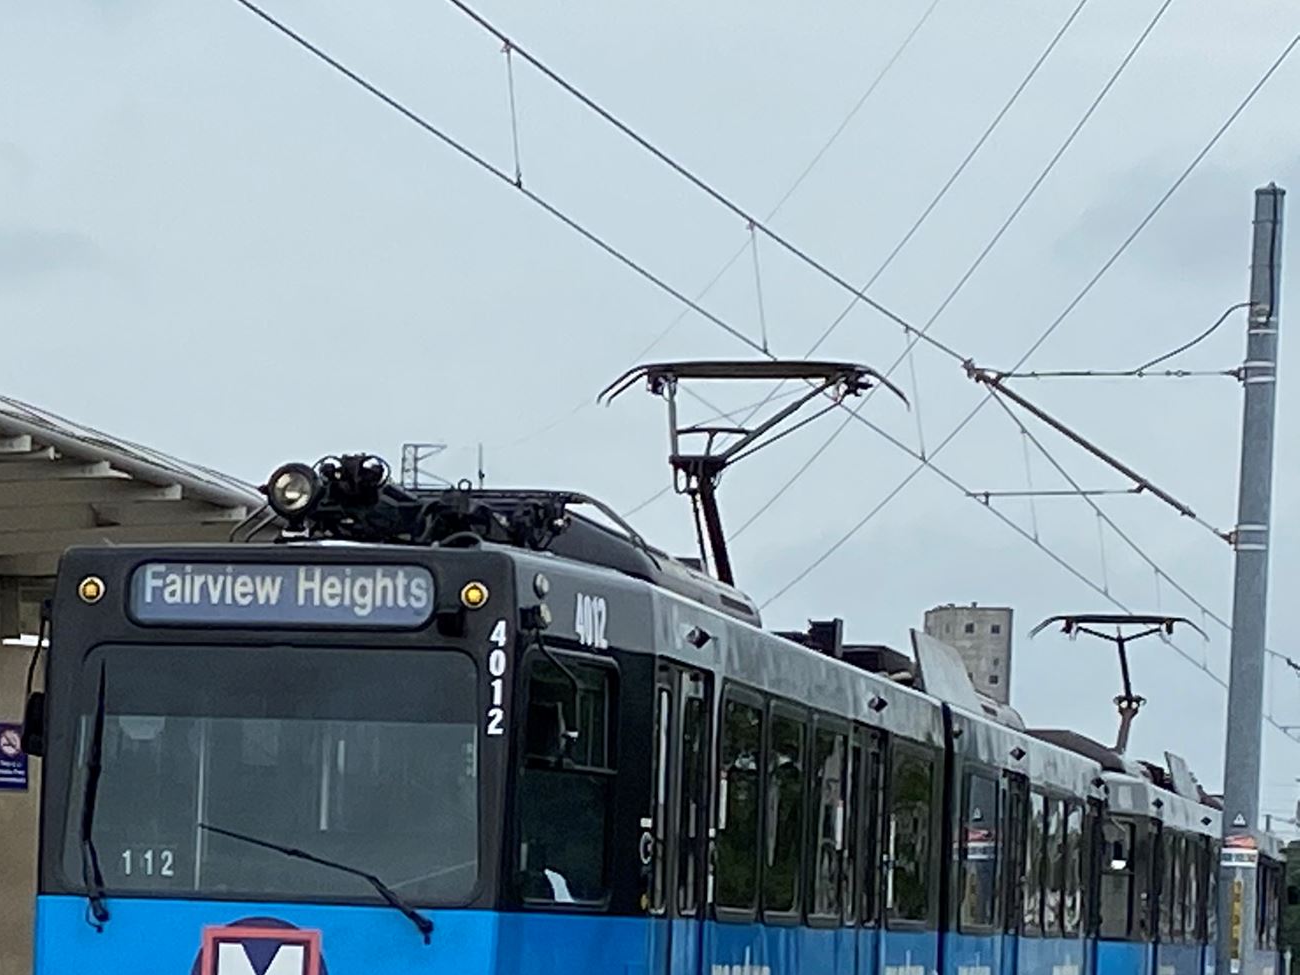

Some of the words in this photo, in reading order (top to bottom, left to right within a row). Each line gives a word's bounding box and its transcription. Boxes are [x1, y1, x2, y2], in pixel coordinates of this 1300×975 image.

[144, 564, 283, 606] Fairview
[298, 564, 428, 617] Heights
[574, 592, 609, 651] 4012
[486, 619, 508, 736] 4012
[121, 849, 175, 877] 112
